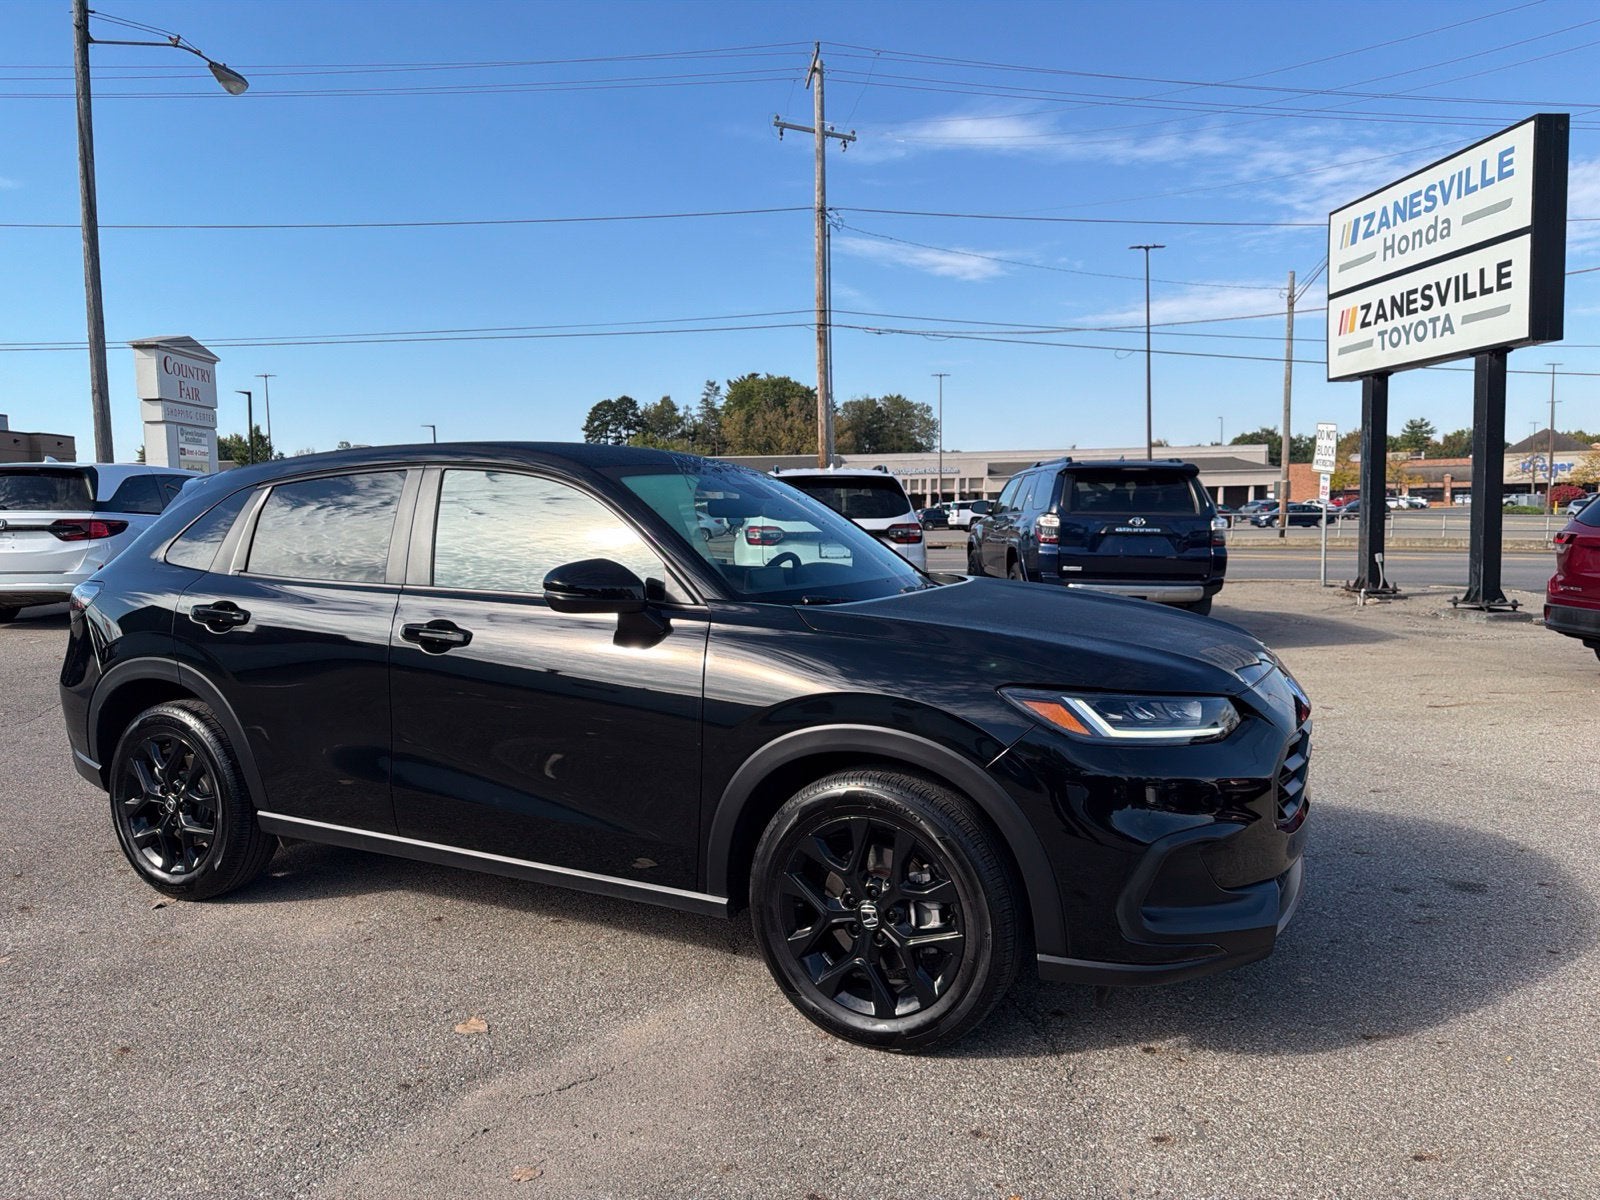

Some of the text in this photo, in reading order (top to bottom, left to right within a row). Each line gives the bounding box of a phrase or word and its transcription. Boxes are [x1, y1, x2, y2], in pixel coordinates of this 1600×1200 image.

[1362, 145, 1515, 241] ZANESVILLE
[1382, 215, 1452, 262] Honda
[1359, 258, 1513, 329] ZANESVILLE
[1377, 312, 1456, 351] TOYOTA
[195, 410, 215, 423] CENTER
[1317, 429, 1336, 441] DO NOT
[1317, 445, 1335, 456] BLOCK
[1520, 455, 1575, 480] Kroger
